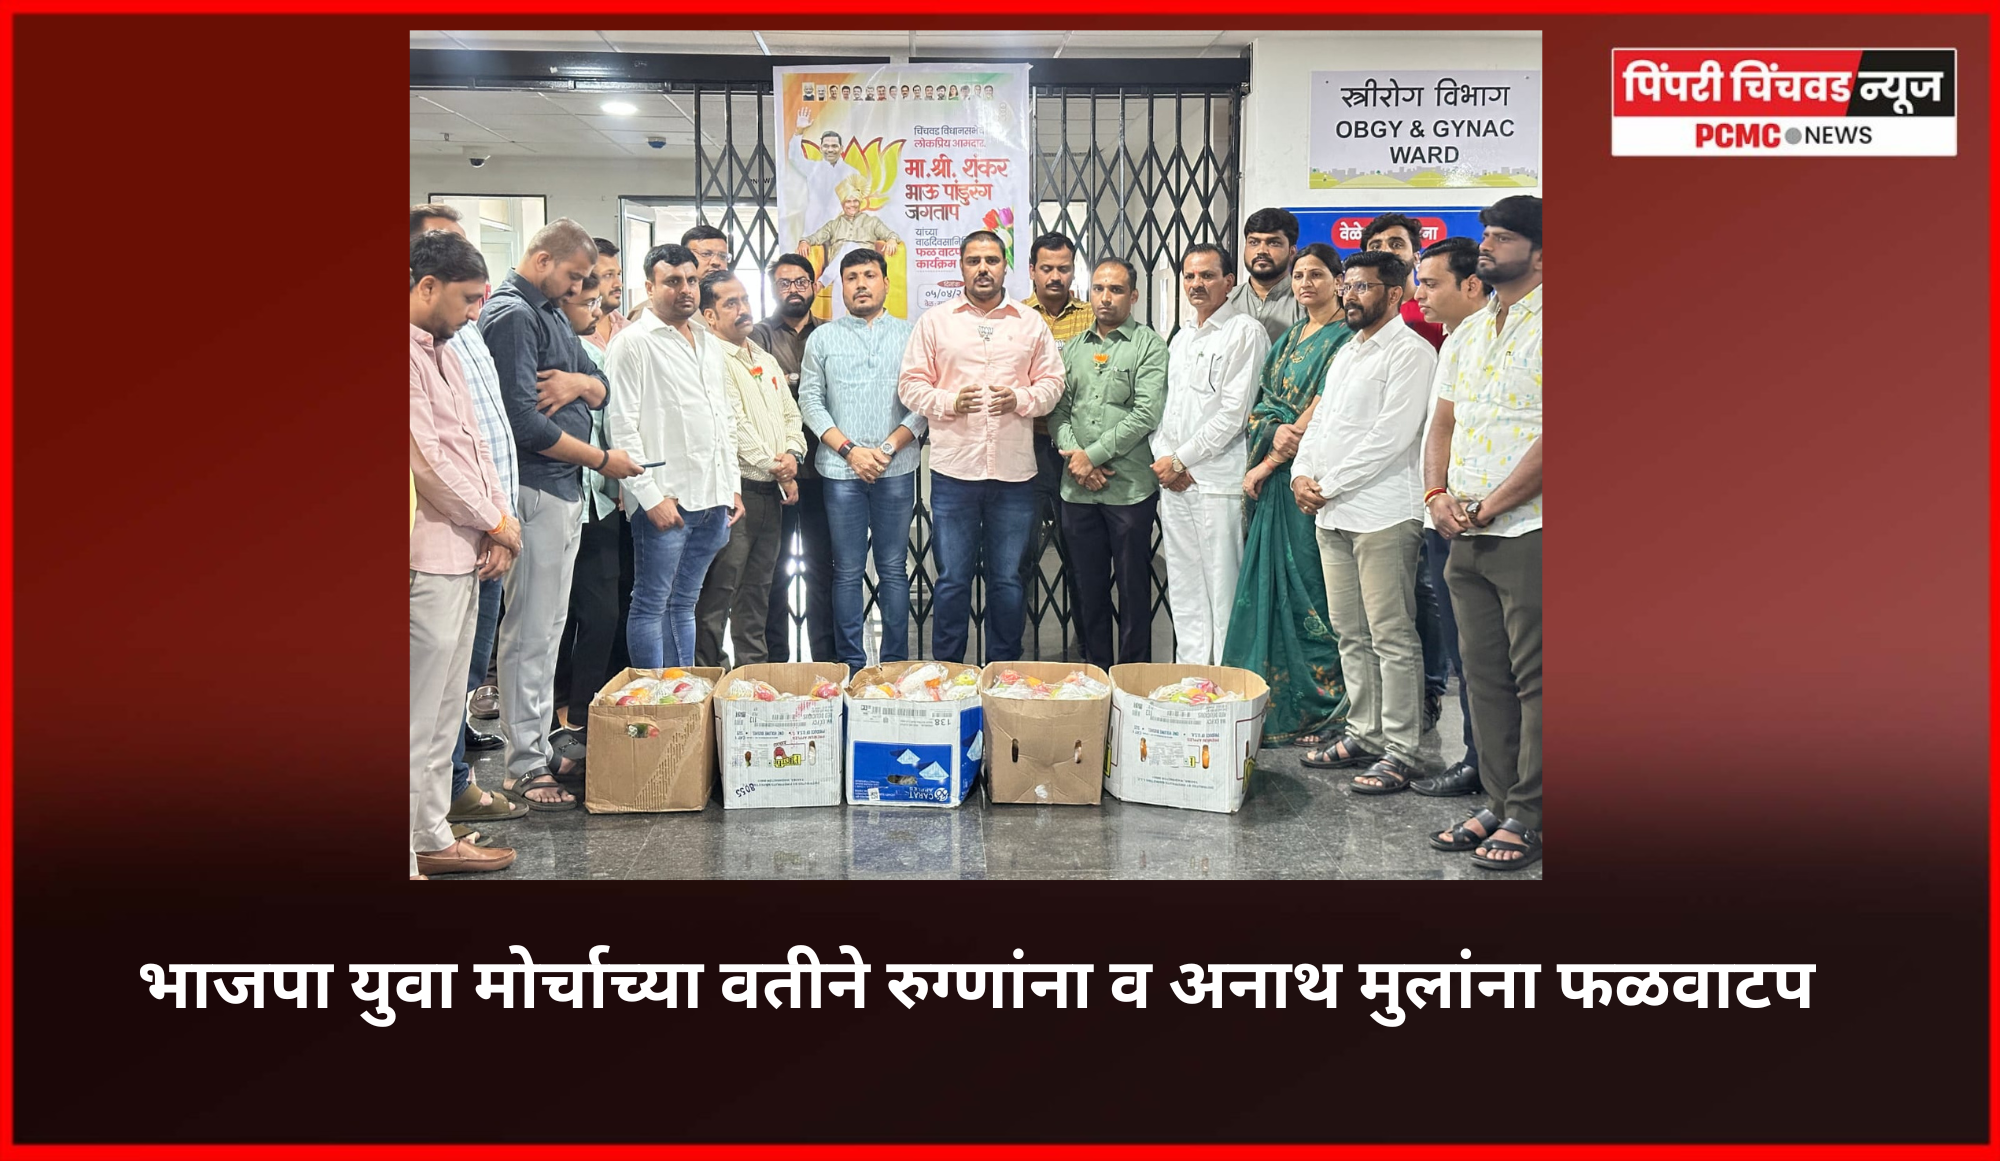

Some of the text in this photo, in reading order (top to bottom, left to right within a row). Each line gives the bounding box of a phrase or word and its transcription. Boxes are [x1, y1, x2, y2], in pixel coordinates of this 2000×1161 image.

[1340, 77, 1510, 108] स्त्रीरोग विभाग
[1336, 119, 1515, 138] OBGY & GYNAC
[914, 137, 951, 148] लोकप्रिय
[1390, 146, 1459, 164] WARD
[962, 153, 1010, 177] शंकर
[905, 179, 993, 206] भाऊ पांडुरंग
[905, 204, 960, 220] जगताप
[916, 248, 937, 257] फळ
[916, 257, 957, 269] कार्यक्रम
[925, 289, 962, 299] ०५/०४/२
[934, 718, 951, 726] 138
[908, 791, 934, 800] CARAT
